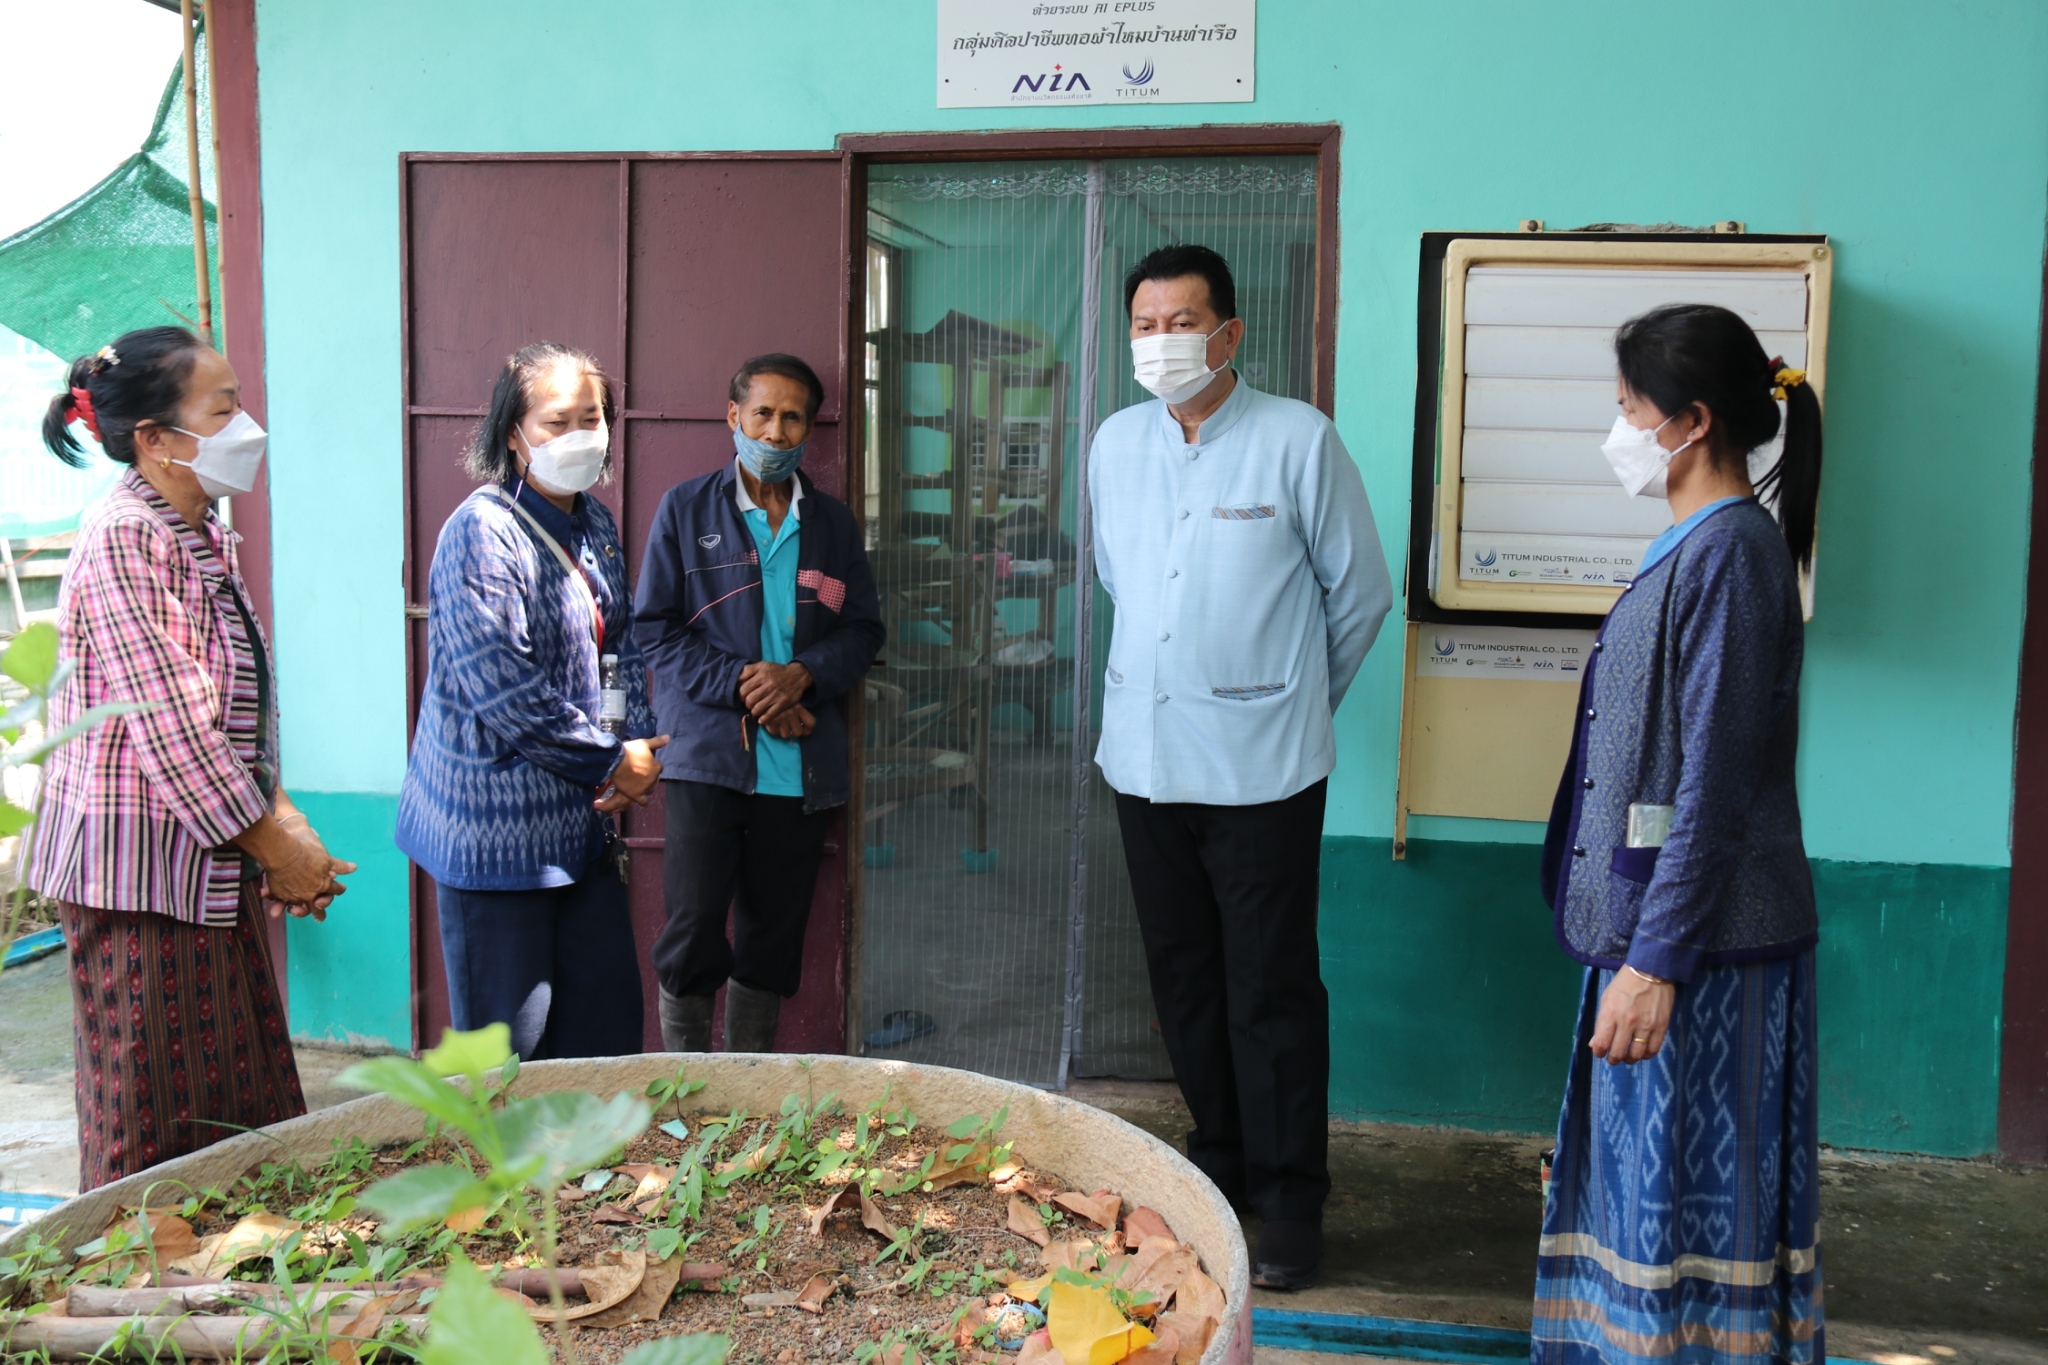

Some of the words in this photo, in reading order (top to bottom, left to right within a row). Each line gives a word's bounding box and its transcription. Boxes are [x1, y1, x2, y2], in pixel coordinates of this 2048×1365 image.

[1032, 3, 1089, 16] ด้วยระบบ
[1114, 1, 1156, 13] EPLUS
[953, 22, 1237, 58] กลุ่มศิลปาชีพทอผ้าไหมบ้านท่าเรือ
[1115, 88, 1160, 97] TITUM
[1501, 553, 1530, 562] TITUM
[1532, 554, 1591, 564] INDUSTRIAL
[1592, 557, 1613, 566] CO.,
[1614, 558, 1635, 567] LTD.
[1459, 643, 1486, 652] TITUM
[1487, 644, 1540, 653] INDUSTRIAL
[1561, 646, 1580, 655] LTD.
